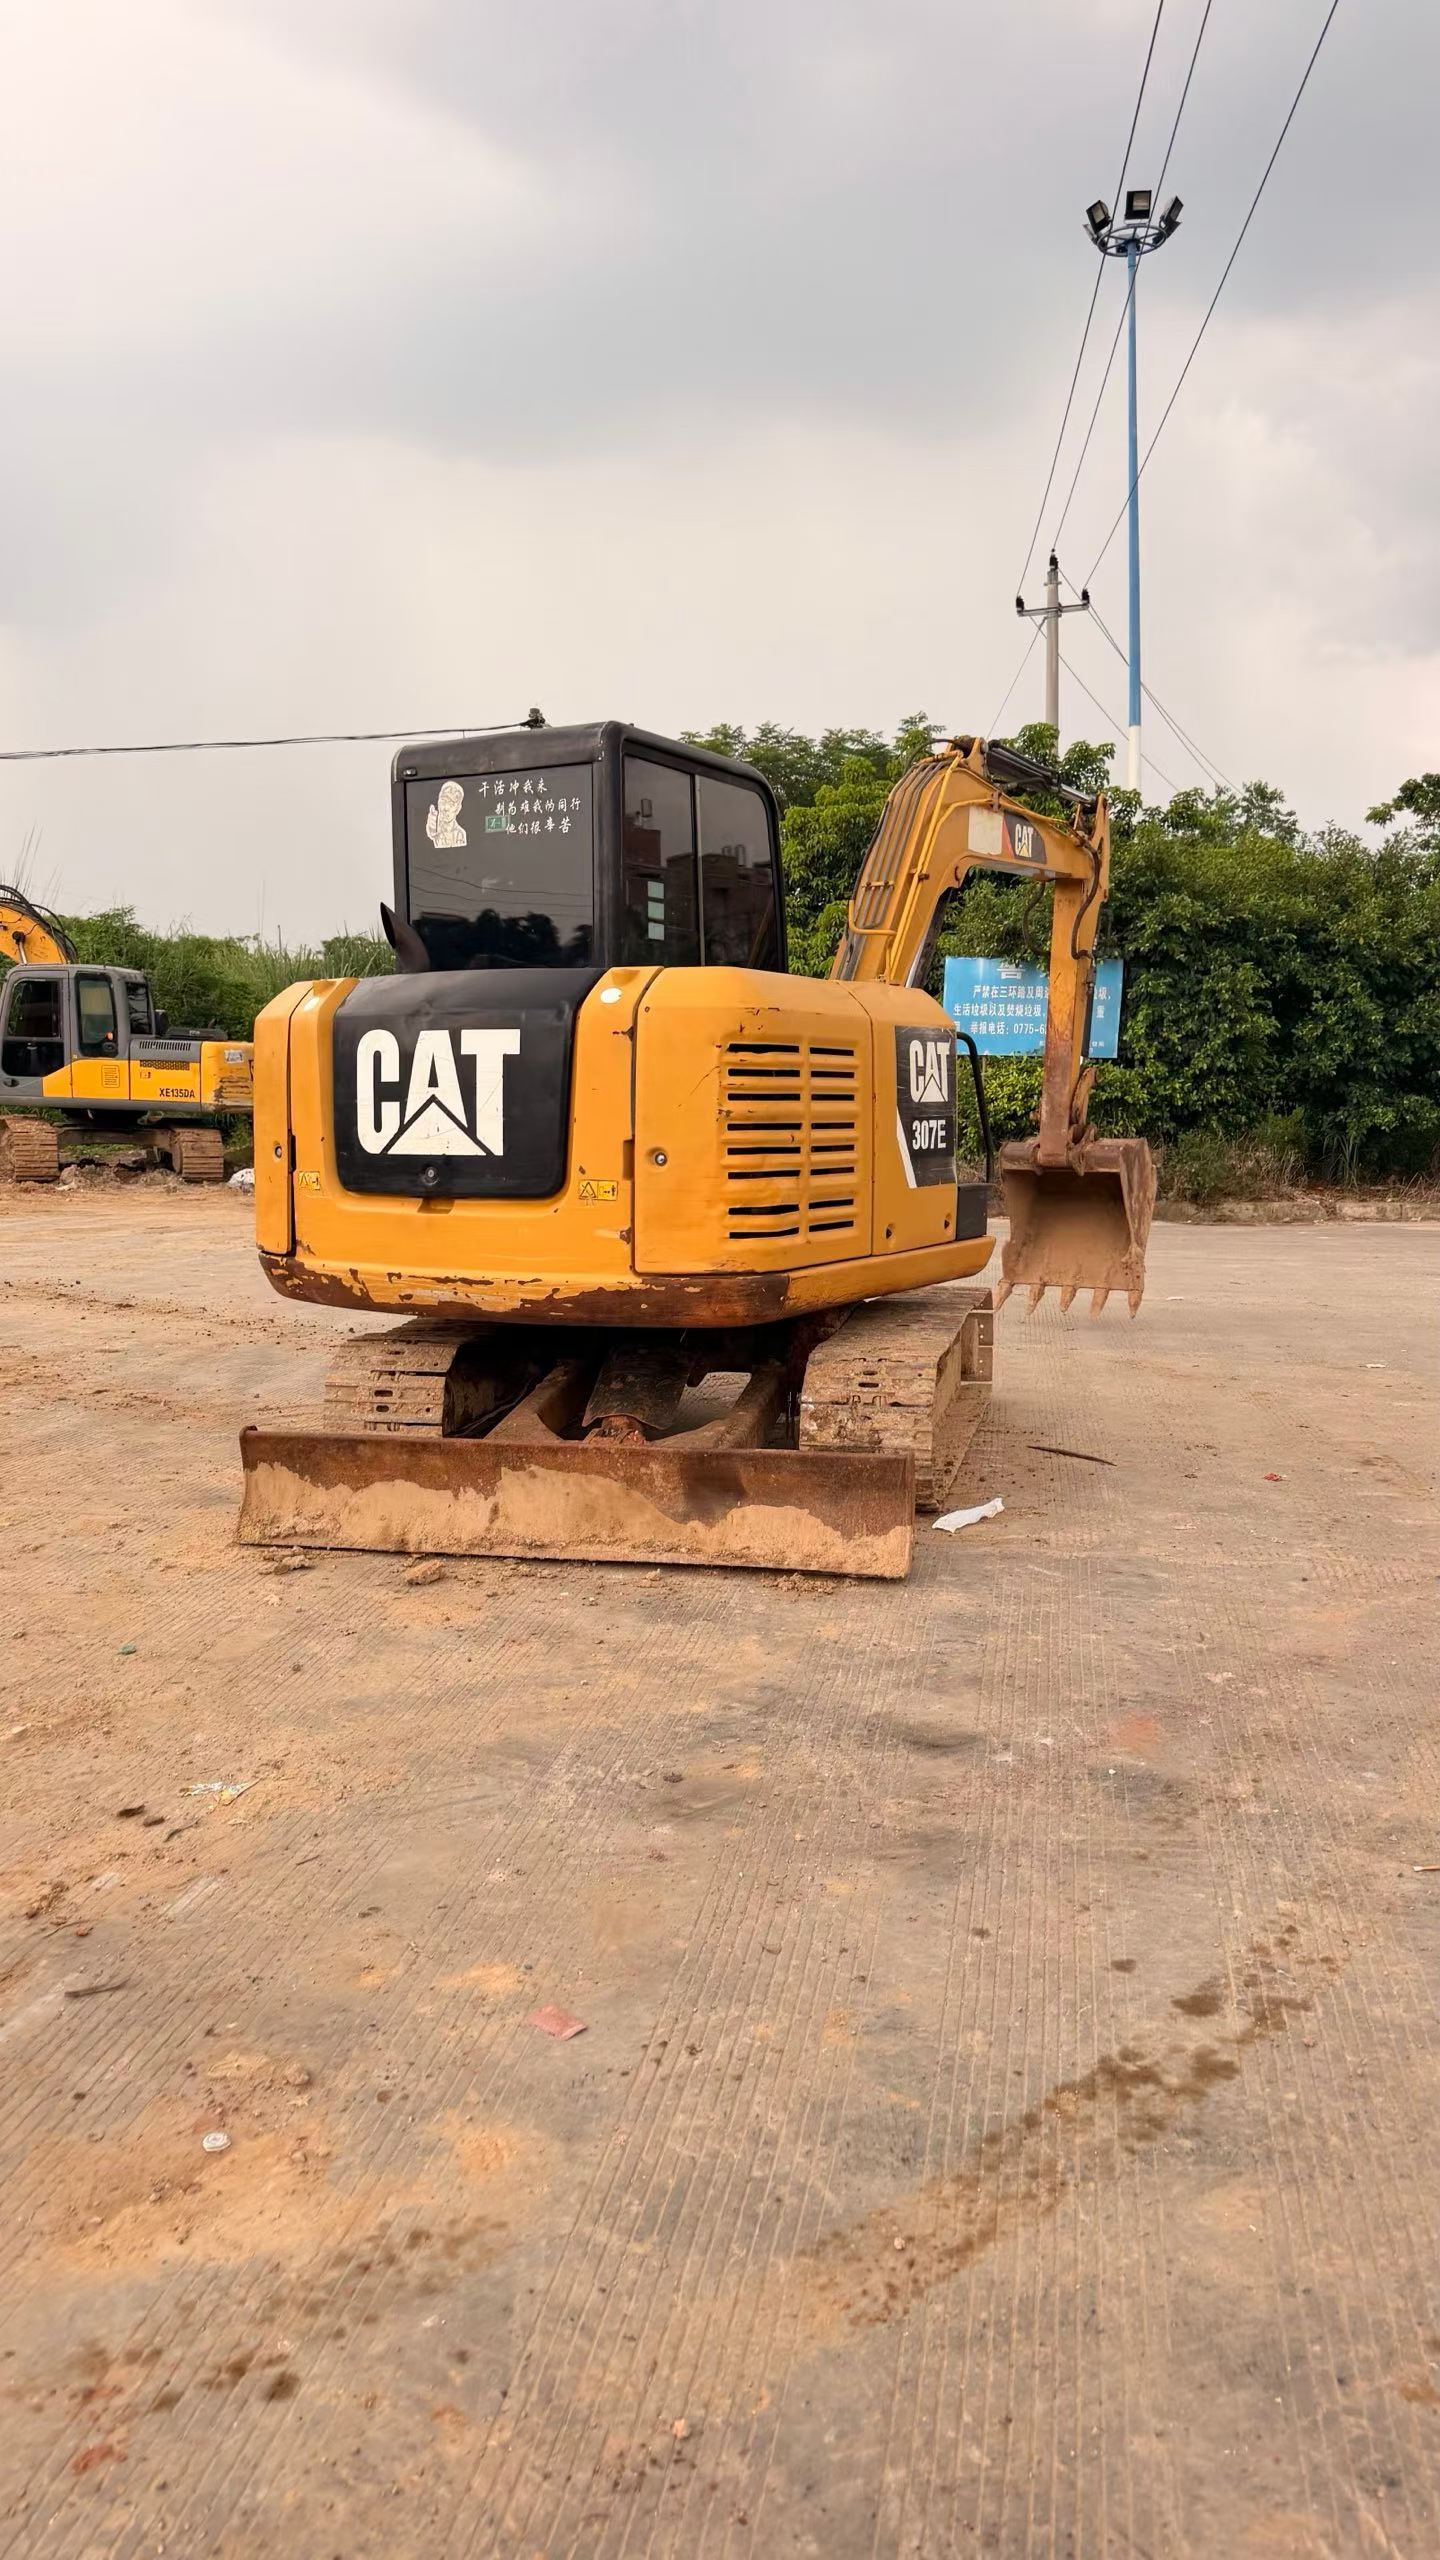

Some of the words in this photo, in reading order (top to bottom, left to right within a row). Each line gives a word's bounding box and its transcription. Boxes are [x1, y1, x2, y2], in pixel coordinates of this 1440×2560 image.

[494, 797, 581, 817] 别为难我的同行
[505, 815, 572, 835] 他们很辛苦
[1015, 823, 1034, 858] CAT
[909, 1039, 950, 1103] CAT
[159, 1087, 195, 1098] XE135DA
[357, 1028, 520, 1156] CAT
[912, 1119, 946, 1150] 307E
